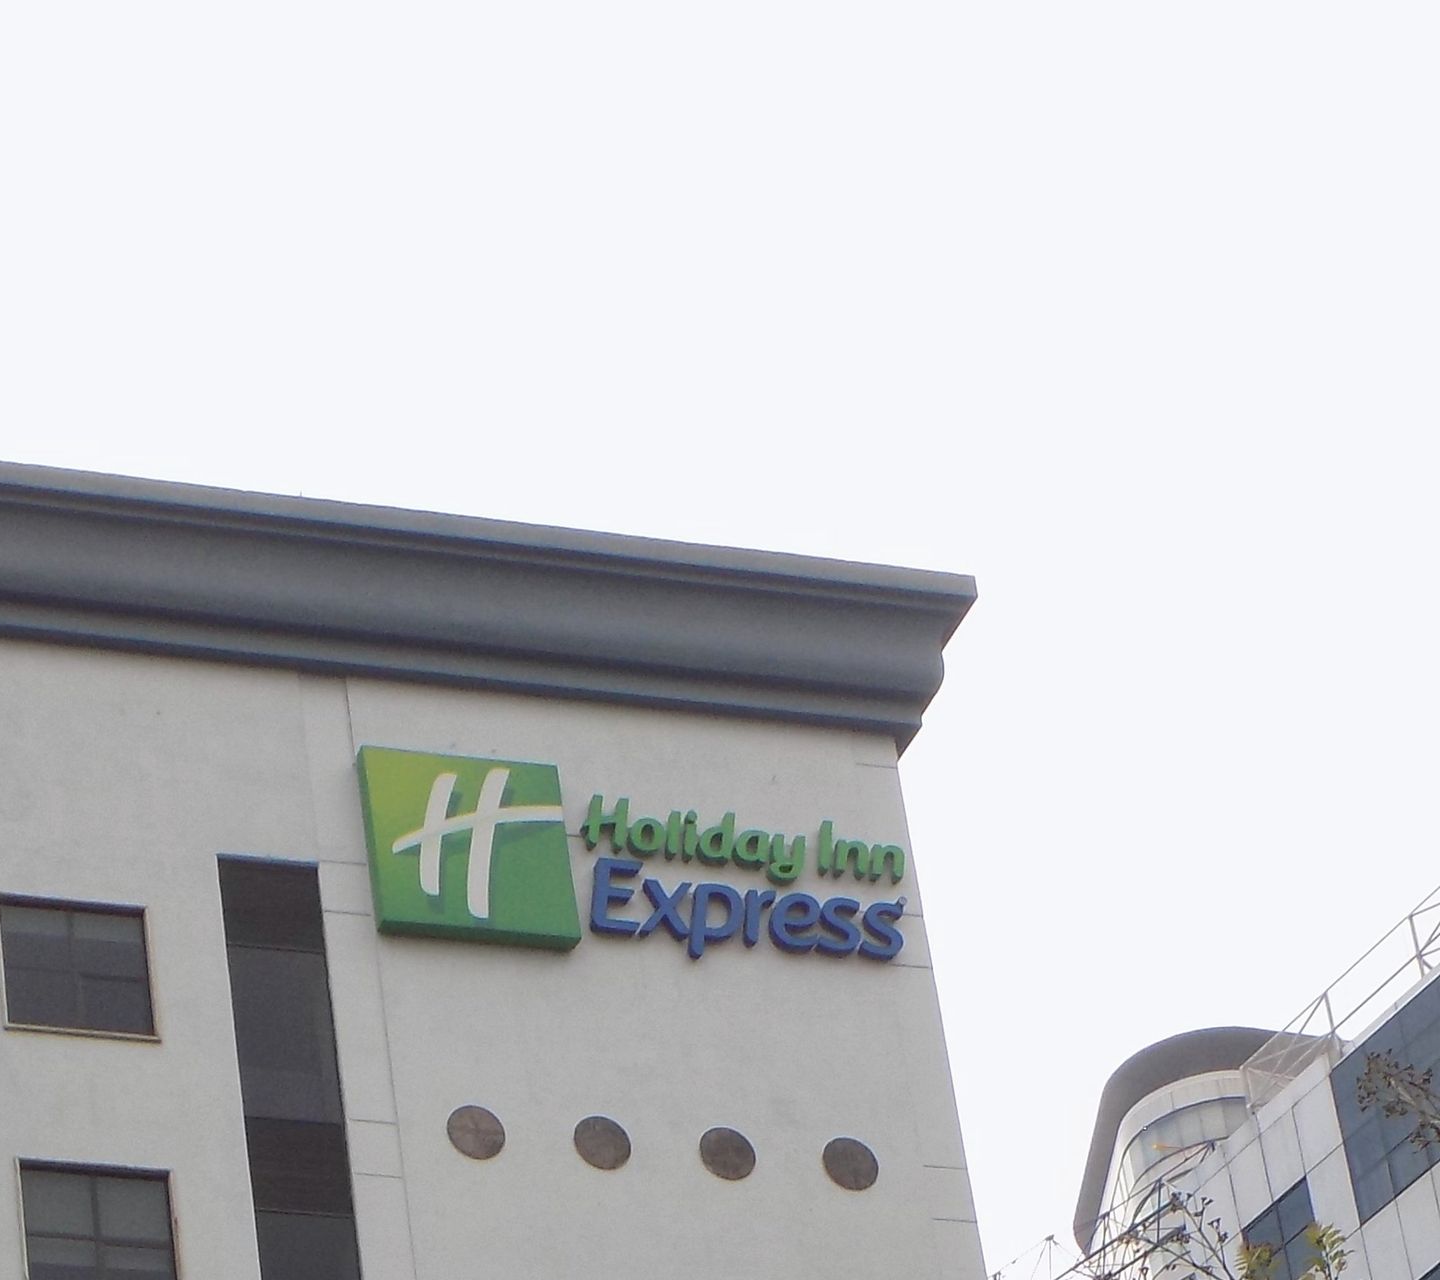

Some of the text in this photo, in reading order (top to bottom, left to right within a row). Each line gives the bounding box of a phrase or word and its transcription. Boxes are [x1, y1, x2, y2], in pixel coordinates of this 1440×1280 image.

[580, 793, 906, 884] Holiday Inn
[590, 857, 904, 959] Express
